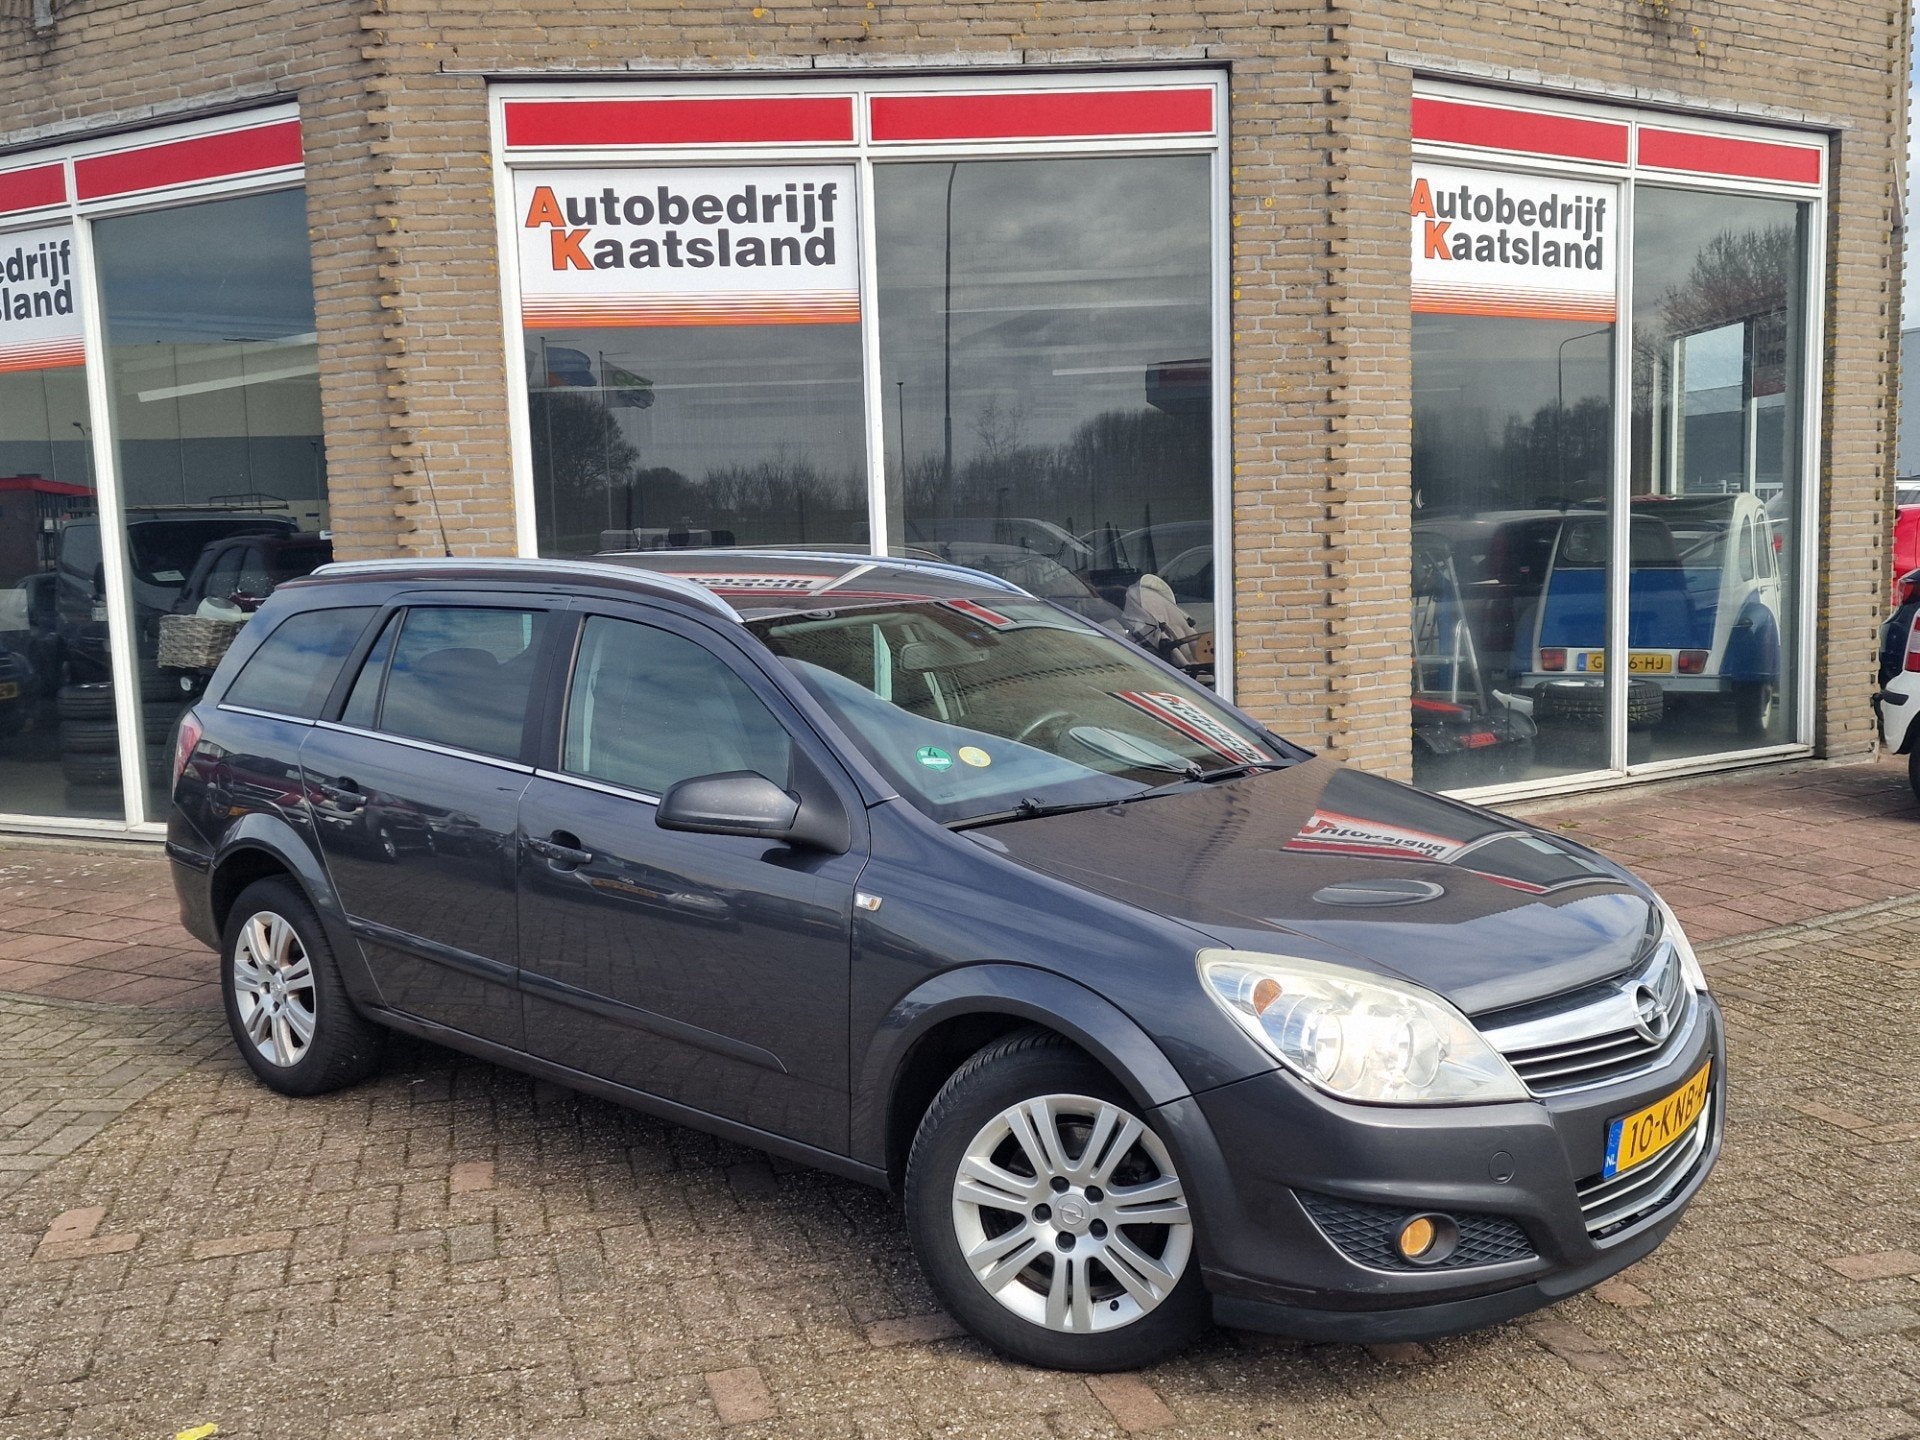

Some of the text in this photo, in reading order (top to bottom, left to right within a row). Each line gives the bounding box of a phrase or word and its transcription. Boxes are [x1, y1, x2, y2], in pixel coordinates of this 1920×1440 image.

[525, 182, 838, 233] Autobedrijf
[1411, 178, 1606, 241] Autobedrijf
[0, 239, 71, 287] drijf
[550, 227, 836, 271] Kaatsland
[1424, 220, 1603, 271] Kaatsland
[0, 279, 74, 321] land
[1605, 1155, 1617, 1168] NL
